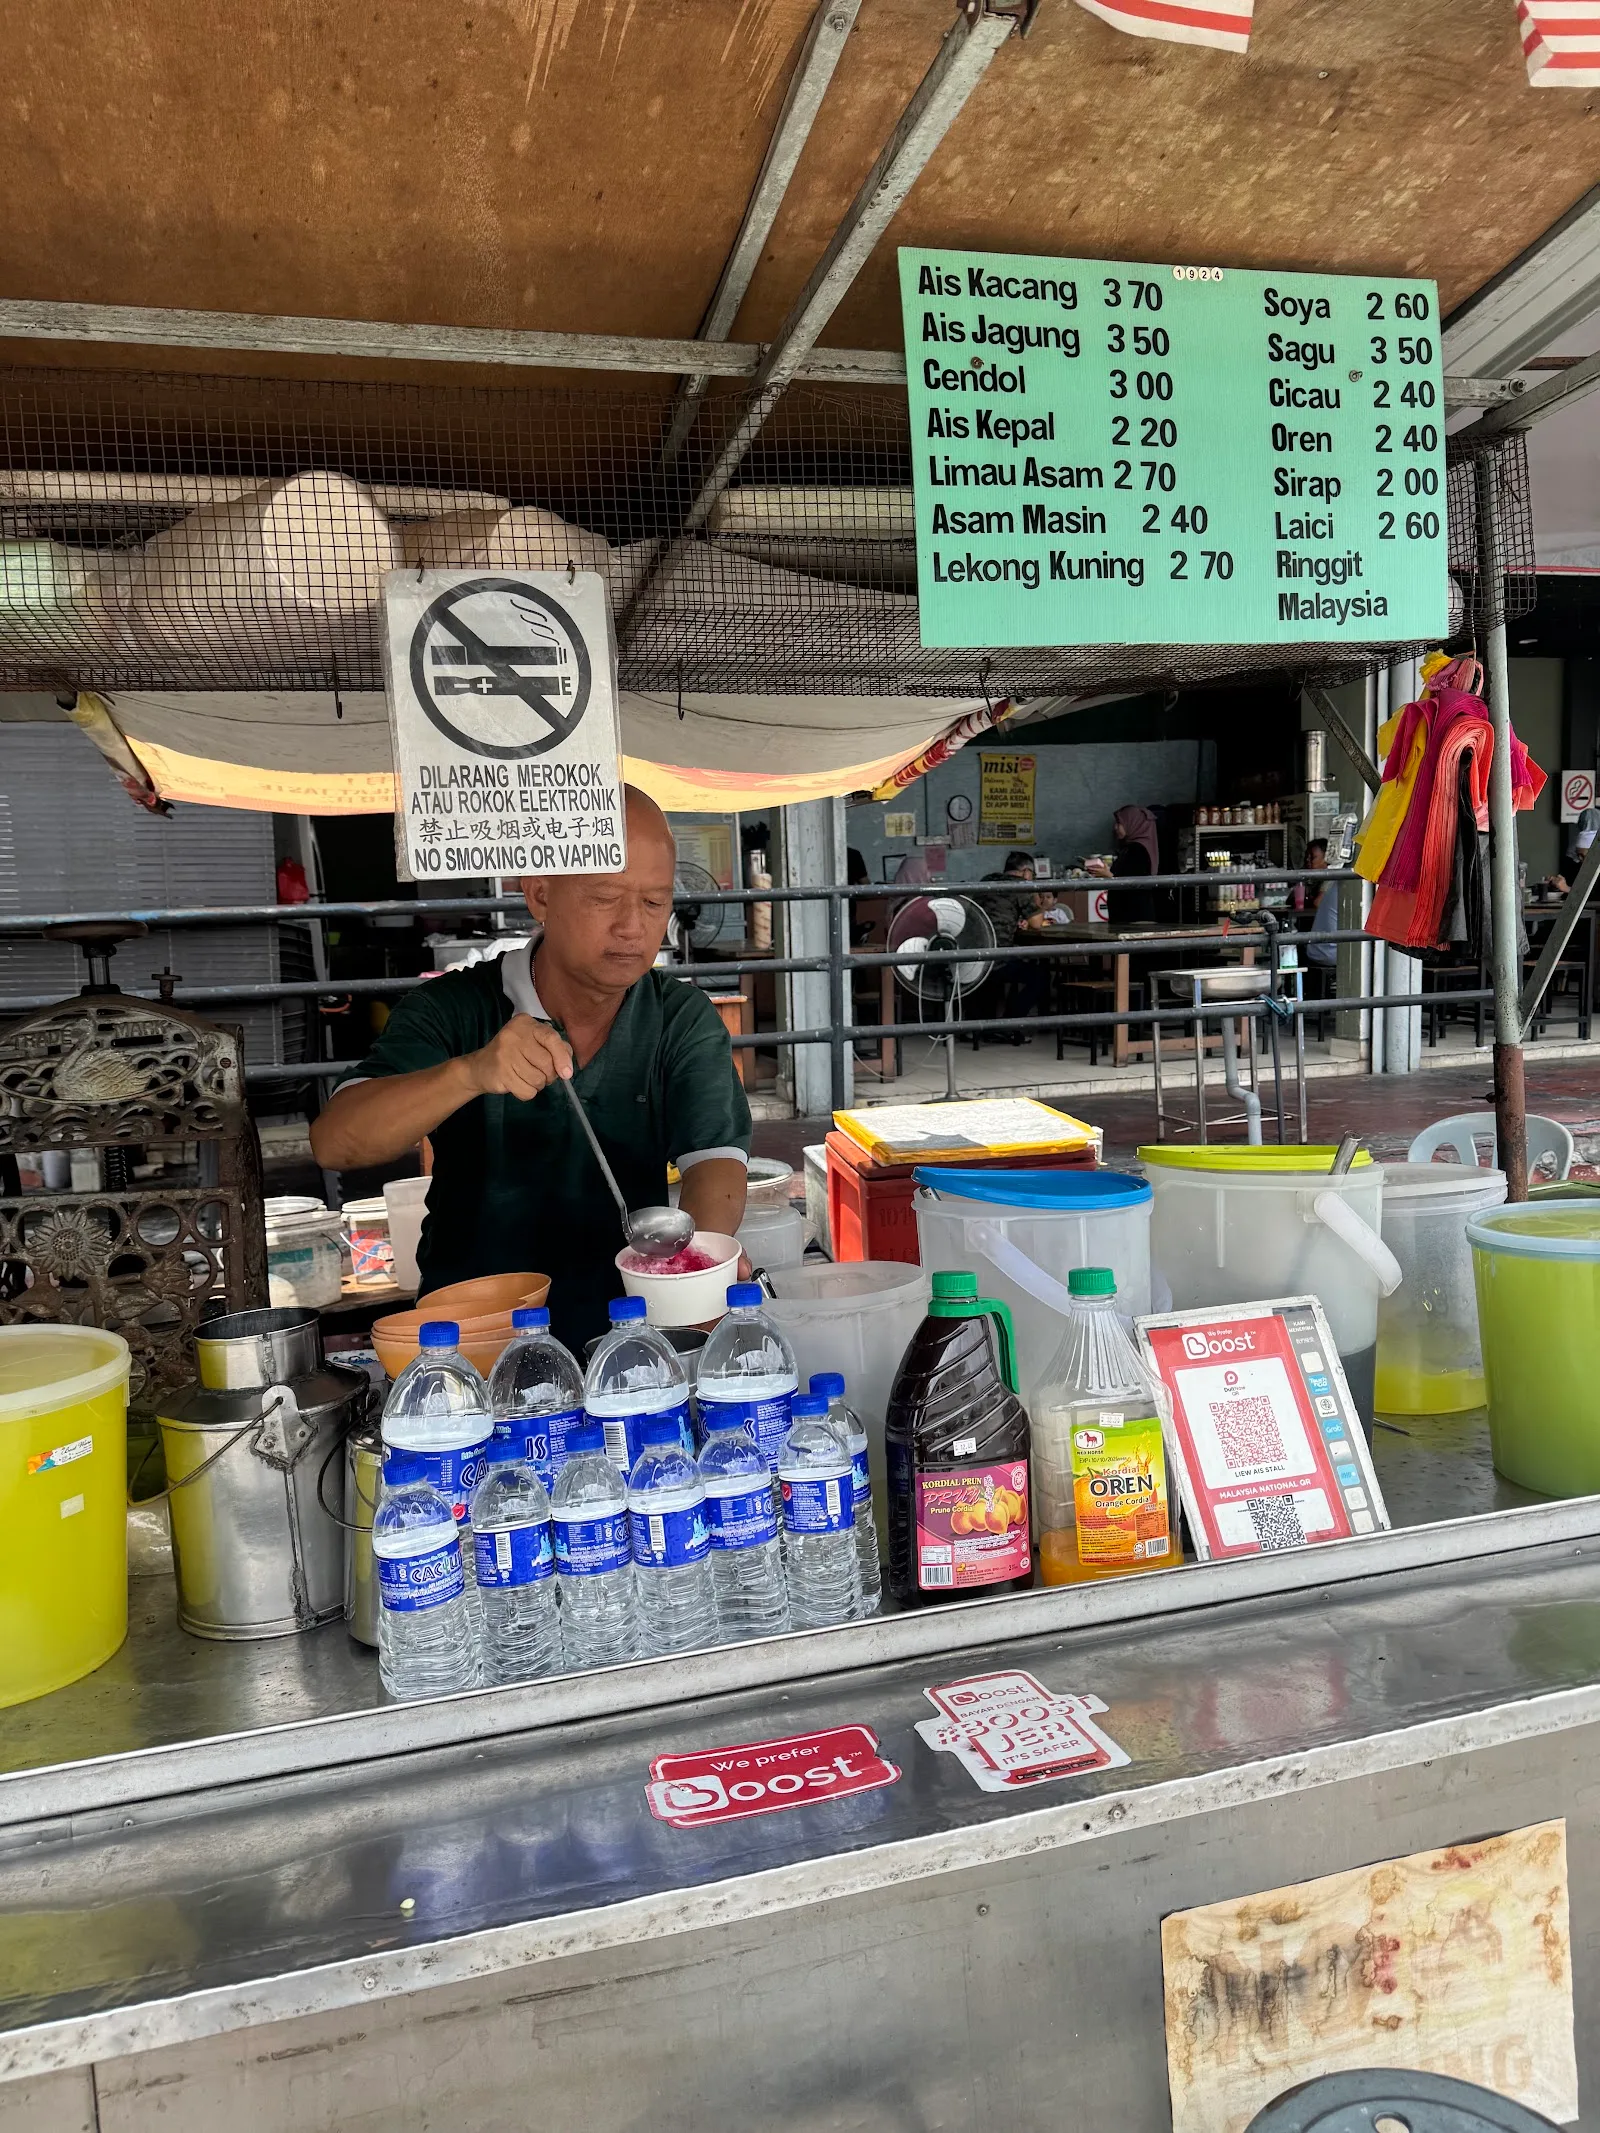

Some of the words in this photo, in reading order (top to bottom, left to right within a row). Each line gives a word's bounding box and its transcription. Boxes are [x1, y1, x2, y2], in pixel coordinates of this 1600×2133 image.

[919, 266, 961, 296] Ais
[968, 268, 1077, 310] Kacang
[1264, 288, 1330, 325] Soya
[923, 312, 965, 342] Ais
[971, 315, 1080, 357] Jagung
[1268, 333, 1334, 370] Sagu
[924, 357, 1025, 393] Cendol
[1269, 378, 1340, 409] Cicau
[928, 408, 969, 438] Ais
[976, 409, 1054, 448] Kepal
[1272, 423, 1331, 452] Oren
[930, 456, 1016, 486] Limau
[1023, 457, 1103, 488] Asam
[1274, 467, 1341, 504] Sirap
[933, 504, 1014, 534] Asam
[1023, 505, 1106, 533] Masin
[1275, 512, 1333, 539] Laici
[934, 552, 1039, 589] Lekong
[1050, 551, 1143, 586] Kuning
[1277, 550, 1362, 585] Ringgit
[1279, 590, 1387, 625] Malaysia
[419, 765, 509, 789] DILARANG
[517, 763, 603, 788] MEROKOK
[411, 791, 453, 815] ATAU
[458, 790, 517, 814] ROKOK
[519, 788, 617, 813] ELEKTRONIK
[418, 816, 615, 844] 禁止吸烟或电子烟
[414, 848, 442, 872] NO
[445, 845, 527, 871] SMOKING
[530, 845, 556, 870] OR
[558, 843, 622, 868] VAPING
[922, 1479, 960, 1490] KORDIAL
[961, 1477, 982, 1487] PRUN
[1090, 1474, 1154, 1497] OREN
[1102, 1465, 1140, 1477] Kordial
[1234, 1469, 1252, 1478] LIEW
[1253, 1467, 1265, 1475] AIS
[1265, 1464, 1286, 1473] STALL
[1095, 1497, 1124, 1509] Orange
[1125, 1494, 1153, 1506] Cordial
[1219, 1487, 1258, 1499] MALAYSIA
[1259, 1482, 1299, 1494] NATIONAL
[1299, 1478, 1312, 1486] QR
[960, 1705, 994, 1719] BAYAR
[995, 1695, 1041, 1711] DENGAN
[710, 1759, 751, 1773] We
[755, 1744, 822, 1769] prefer
[1002, 1752, 1031, 1766] IT'S
[1032, 1739, 1082, 1757] SAFER
